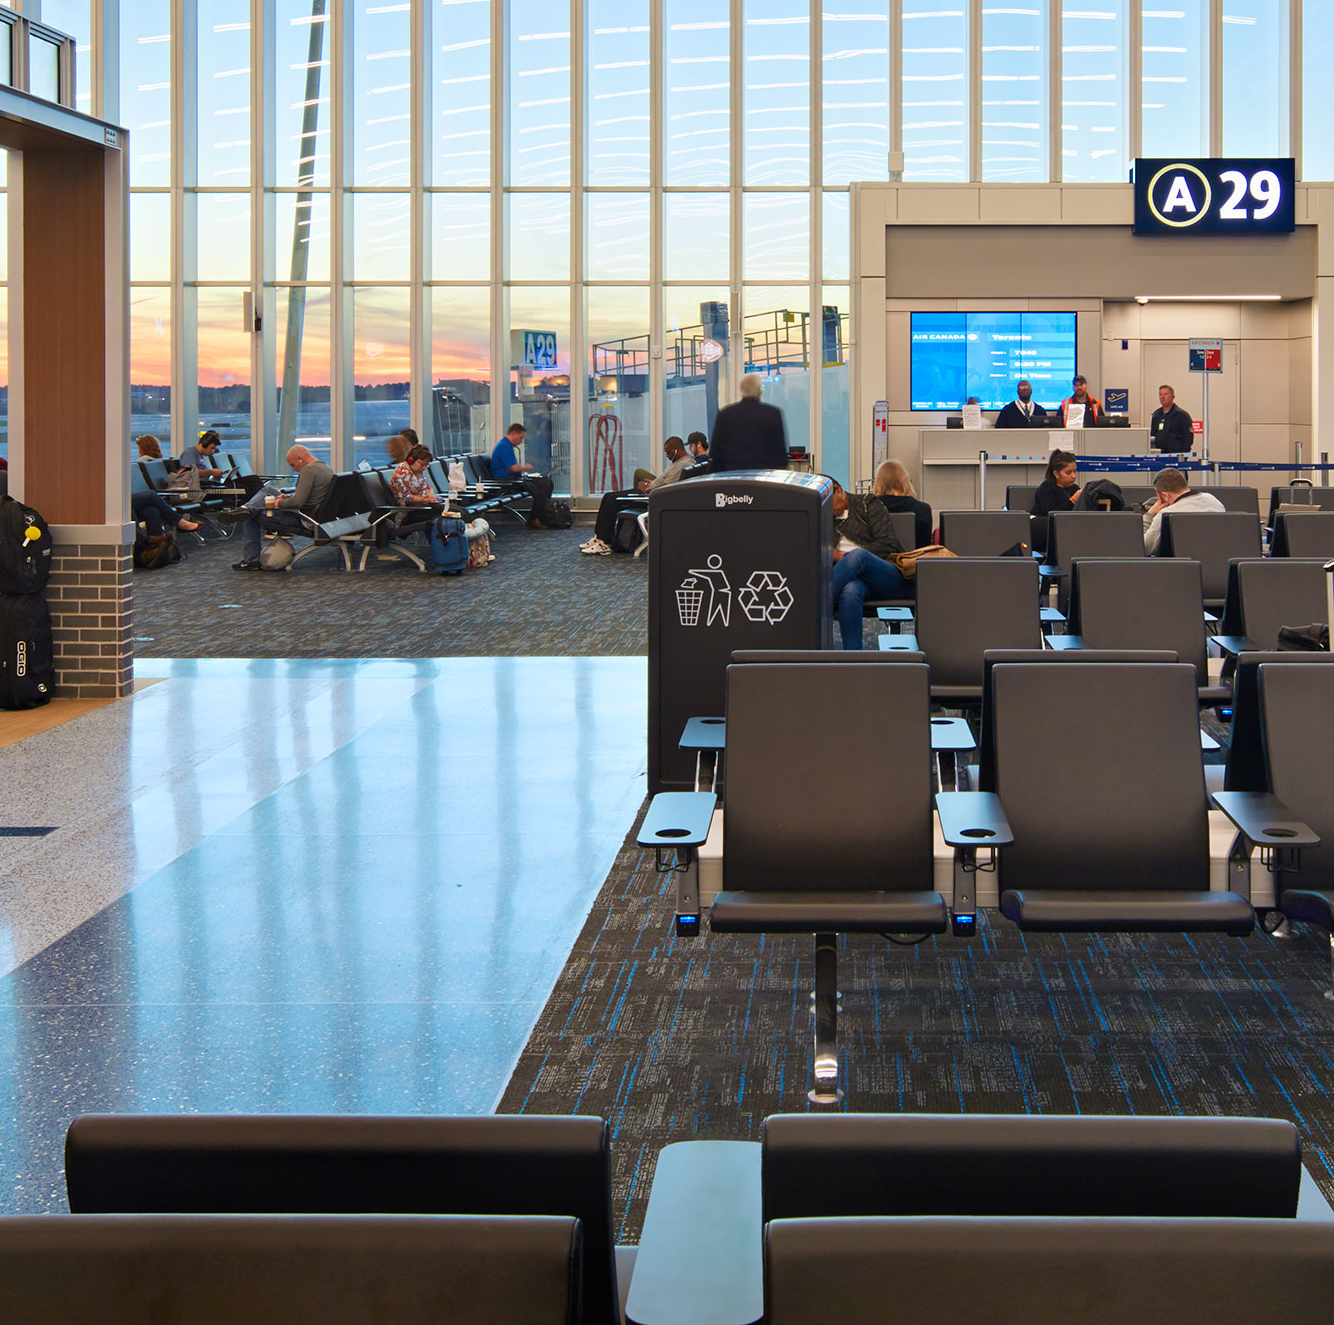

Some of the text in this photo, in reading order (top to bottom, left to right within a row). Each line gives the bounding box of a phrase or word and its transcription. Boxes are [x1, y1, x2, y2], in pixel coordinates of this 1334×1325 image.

[1162, 170, 1281, 220] A 29
[526, 332, 556, 366] A29
[715, 492, 754, 508] Bigbelly
[16, 640, 27, 677] OGIO
